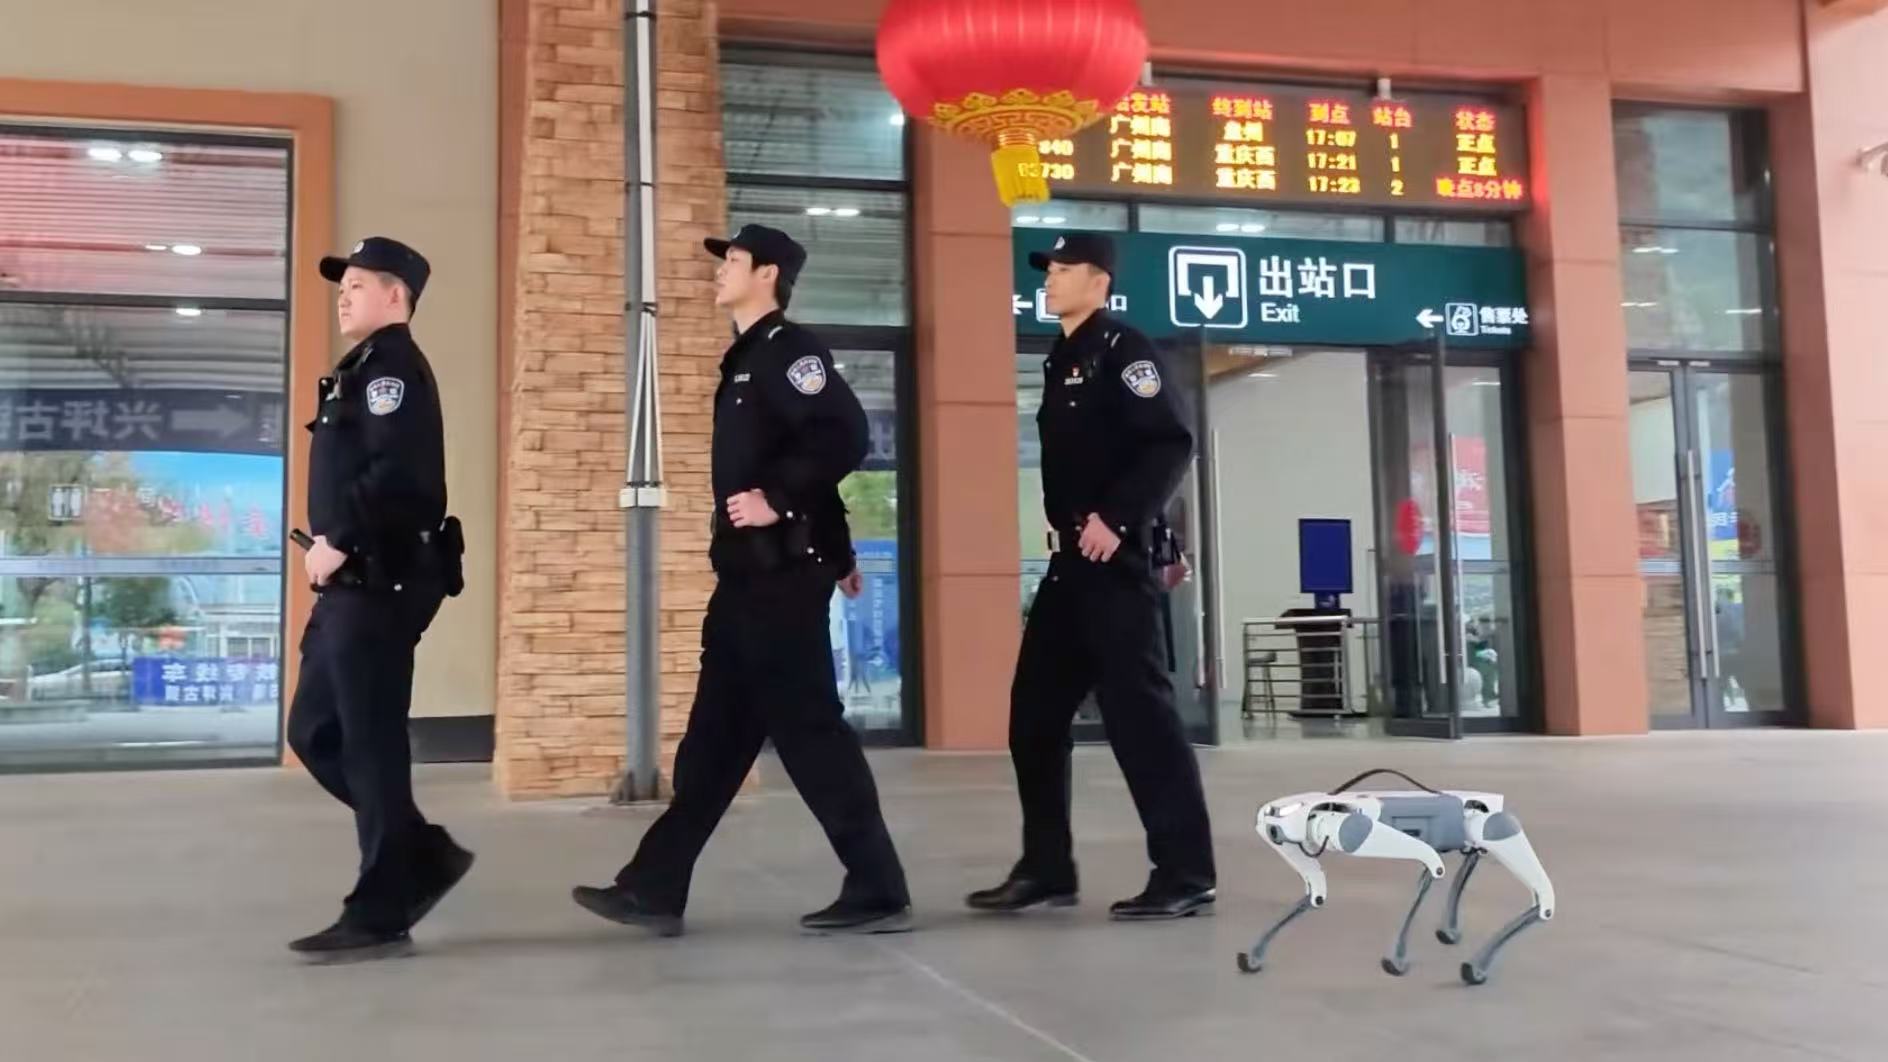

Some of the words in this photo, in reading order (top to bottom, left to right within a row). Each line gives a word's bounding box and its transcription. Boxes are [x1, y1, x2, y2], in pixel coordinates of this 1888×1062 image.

[1213, 97, 1273, 120] 终到站
[1309, 103, 1350, 124] 到点
[1373, 107, 1412, 128] 站台
[1456, 111, 1496, 131] 状态
[1109, 114, 1171, 137] 广州南
[1306, 129, 1356, 147] 17:07
[1389, 133, 1399, 149] 1
[1456, 134, 1496, 153] 正点
[1110, 138, 1172, 161] 广州南
[1215, 143, 1275, 166] 重庆西
[1307, 152, 1357, 170] 17:21
[1391, 157, 1400, 173] 1
[1458, 157, 1497, 176] 正点
[1110, 162, 1173, 185] 广州南
[1216, 167, 1276, 190] 重庆西
[1308, 175, 1360, 193] 17:23
[1391, 180, 1404, 196] 2
[1258, 255, 1375, 298] 出站口
[1261, 302, 1300, 323] Exit
[1479, 306, 1529, 324] 售票处
